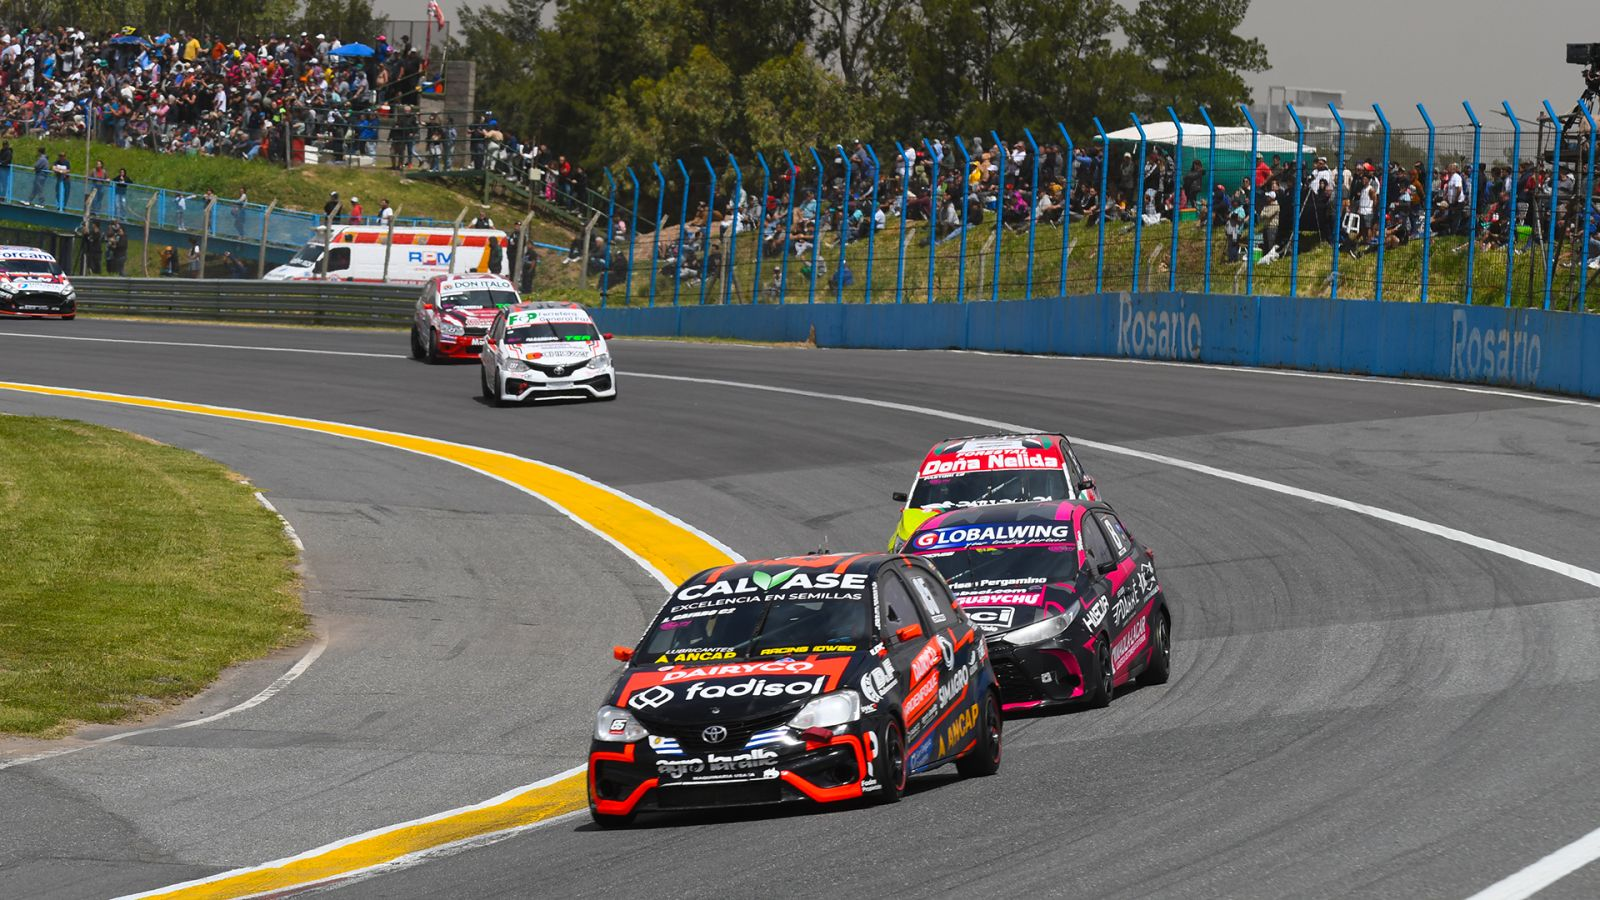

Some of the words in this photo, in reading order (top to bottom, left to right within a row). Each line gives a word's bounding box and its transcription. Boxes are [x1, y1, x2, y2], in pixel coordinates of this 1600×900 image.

[0, 250, 52, 260] orcam
[1117, 289, 1201, 358] Rosario
[1450, 309, 1541, 384] Rosario
[921, 457, 982, 476] Doña
[987, 452, 1059, 469] Nelida
[917, 525, 1069, 547] GLOBALWING
[980, 577, 1048, 588] Pergamino
[670, 595, 761, 614] EXCELENCIA
[764, 593, 785, 602] EN
[792, 591, 863, 601] SEMILLAS
[665, 646, 736, 655] LUBRICANTES
[673, 651, 737, 663] ANCAP
[759, 646, 809, 656] RACING
[662, 661, 815, 682] DAIRYCO
[685, 675, 826, 700] fadisol
[947, 702, 979, 751] ANCAP
[656, 758, 706, 779] agro
